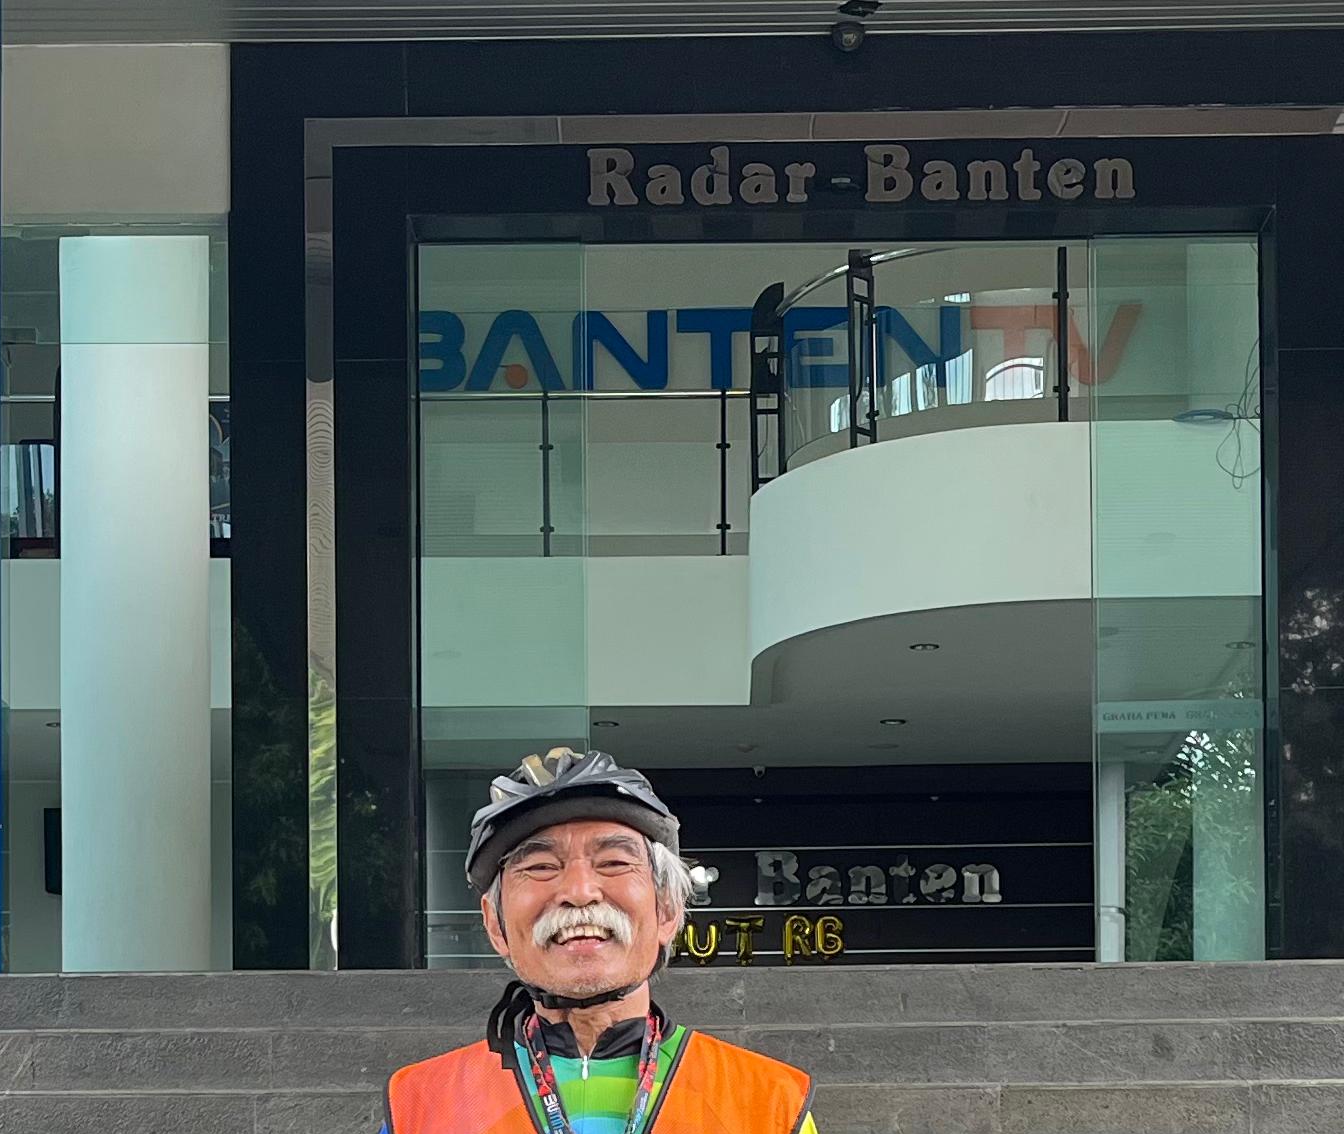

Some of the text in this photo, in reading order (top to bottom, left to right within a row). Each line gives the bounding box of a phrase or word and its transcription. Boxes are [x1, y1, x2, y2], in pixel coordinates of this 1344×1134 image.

[586, 143, 1137, 206] Radar Banten
[754, 850, 1003, 905] Banten
[670, 914, 766, 967] UT
